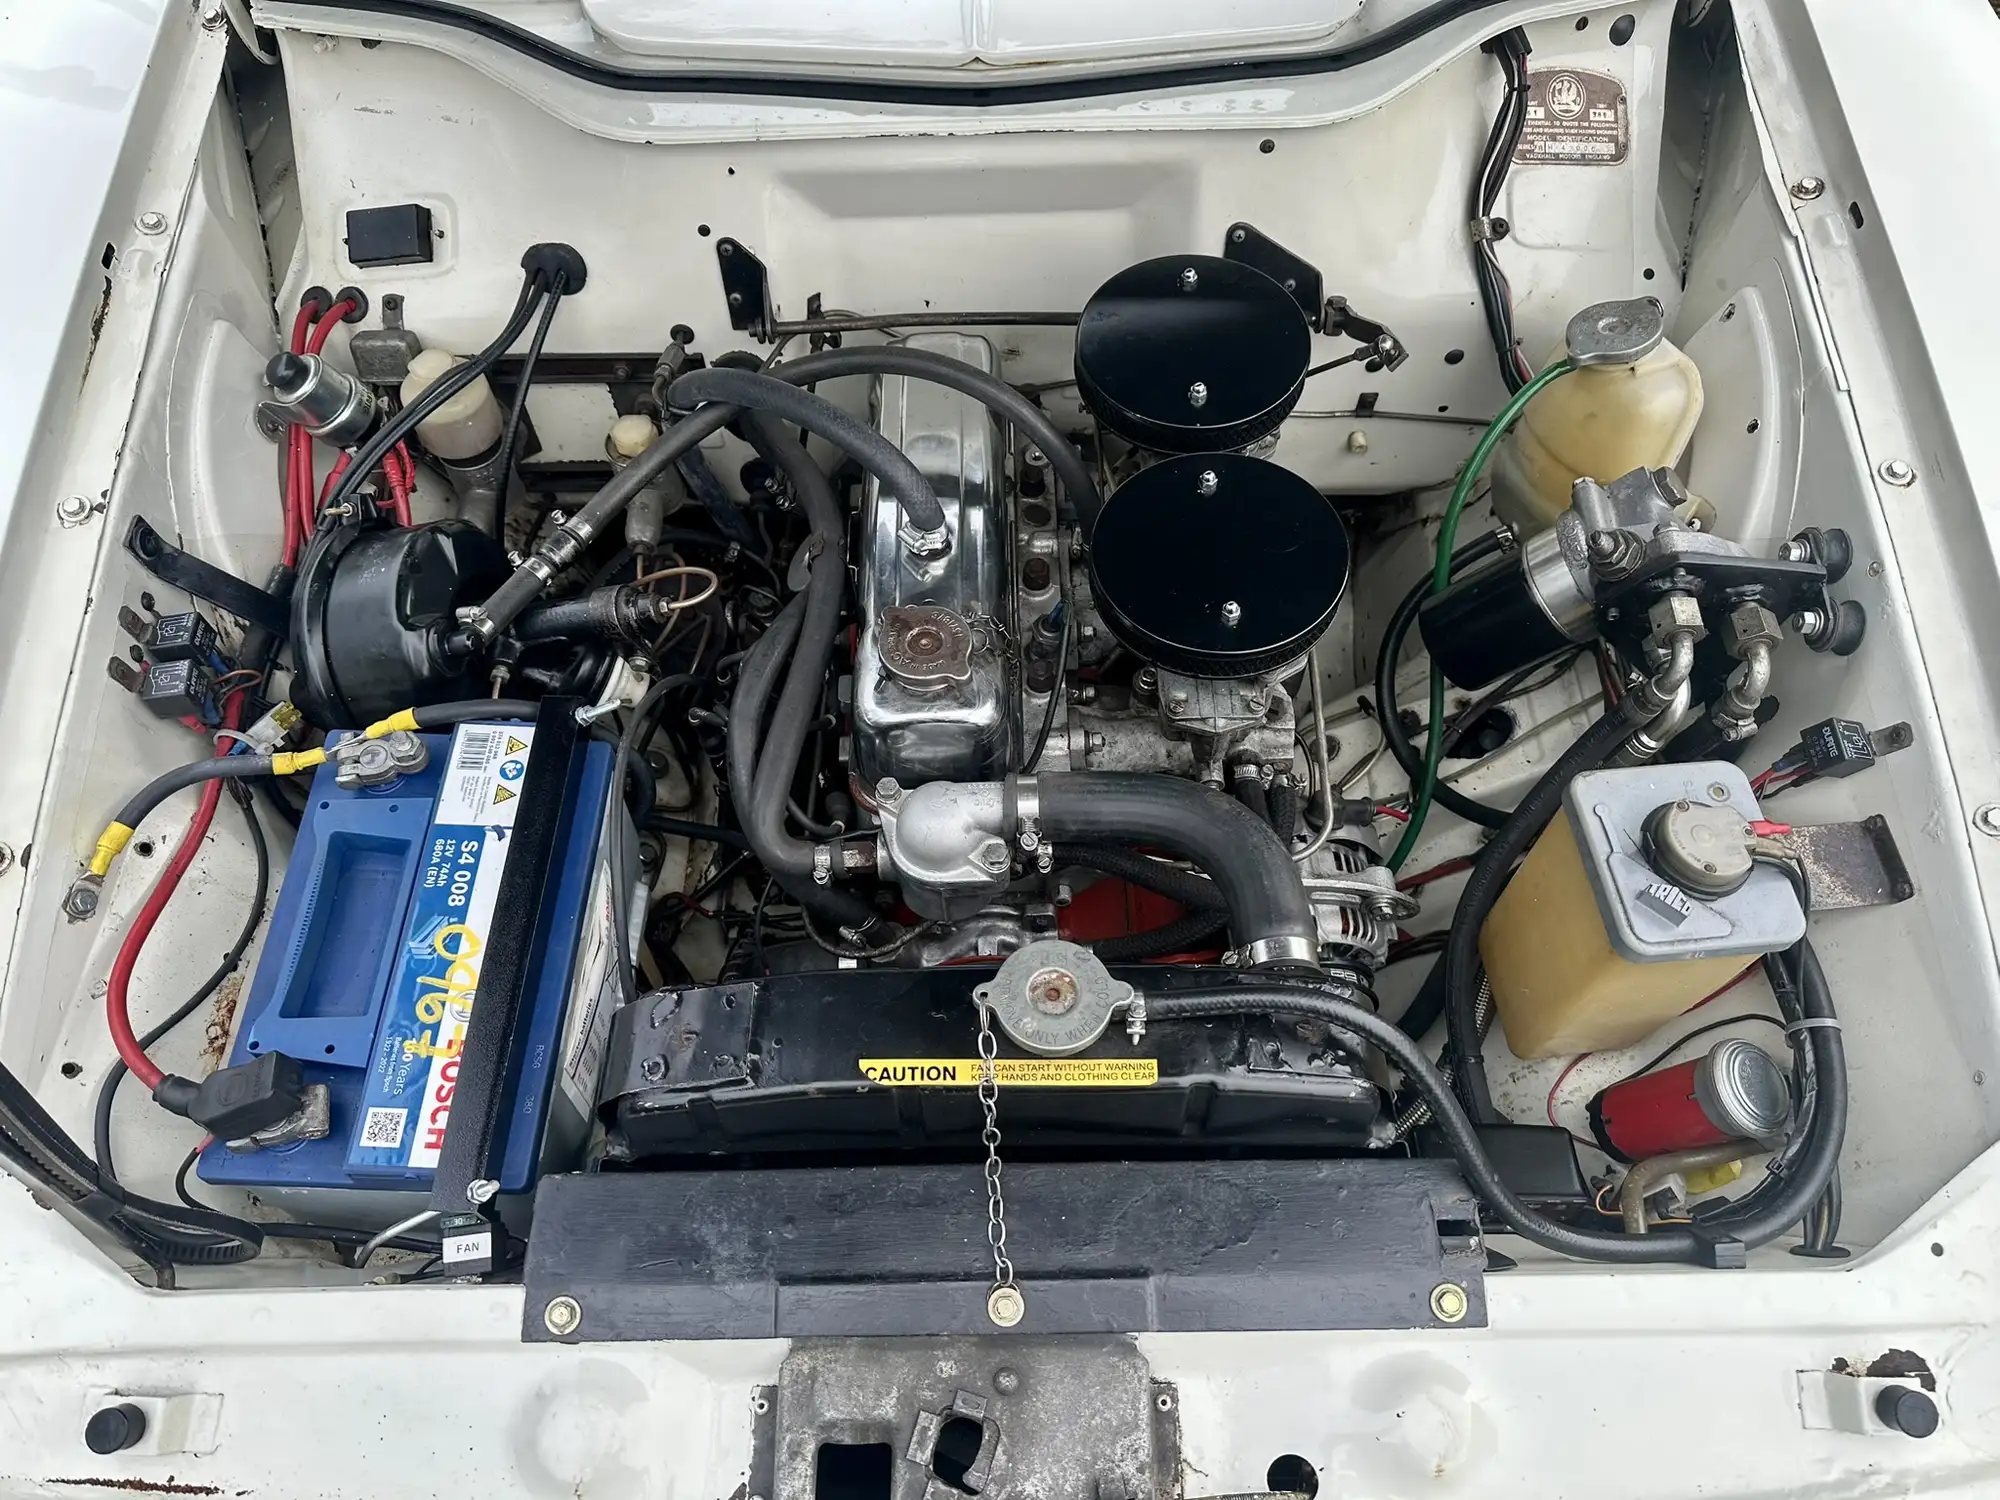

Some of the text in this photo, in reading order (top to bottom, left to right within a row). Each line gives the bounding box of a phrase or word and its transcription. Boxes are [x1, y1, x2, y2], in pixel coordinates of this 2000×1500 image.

[423, 838, 445, 888] 680A (EN)
[436, 839, 456, 887] 12V 74Ah
[457, 840, 479, 865] S4
[447, 870, 472, 907] 008
[1646, 882, 1693, 916] TRICO
[1064, 1014, 1100, 1042] WHEN
[1095, 976, 1110, 1009] COLD
[393, 1062, 413, 1095] Years
[865, 1066, 956, 1081] CAUTION
[993, 1064, 1016, 1072] CAN
[1018, 1063, 1051, 1072] START
[1053, 1063, 1103, 1072] WITHOUT
[1104, 1062, 1155, 1071] WARNING
[1001, 1073, 1038, 1081] HANDS
[1040, 1072, 1061, 1081] AND
[1064, 1072, 1118, 1081] CLOTHING
[1121, 1071, 1155, 1080] CLEAR
[456, 1242, 480, 1254] FAN
